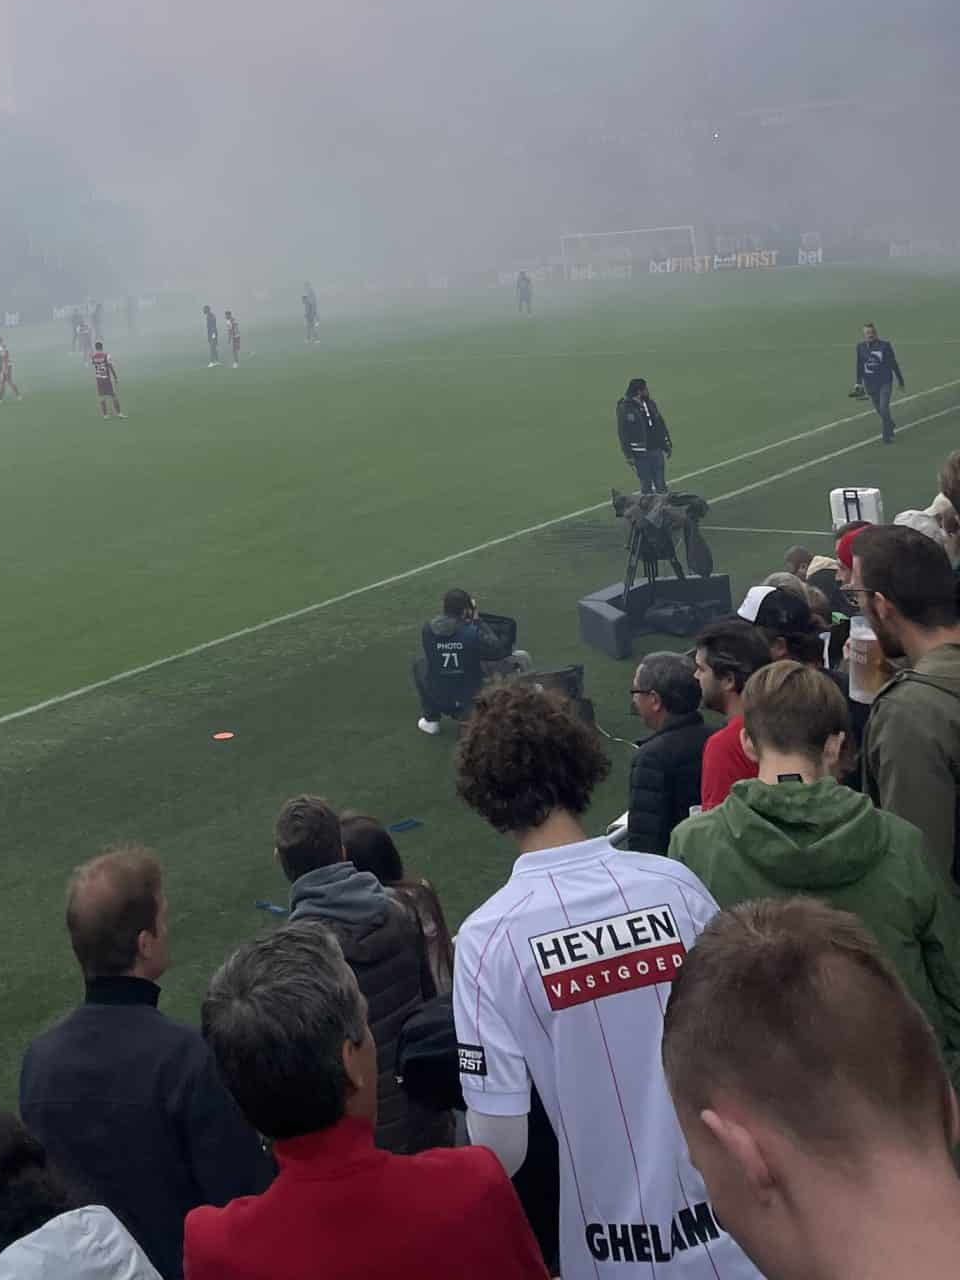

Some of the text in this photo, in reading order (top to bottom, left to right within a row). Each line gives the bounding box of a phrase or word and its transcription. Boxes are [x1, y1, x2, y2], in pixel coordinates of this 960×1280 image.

[437, 642, 463, 650] PHOTO
[442, 653, 459, 668] 71
[536, 911, 676, 970] HEYLEN
[551, 953, 684, 999] VASTGOED
[459, 1057, 483, 1071] RST
[585, 1201, 721, 1263] GHELAM
